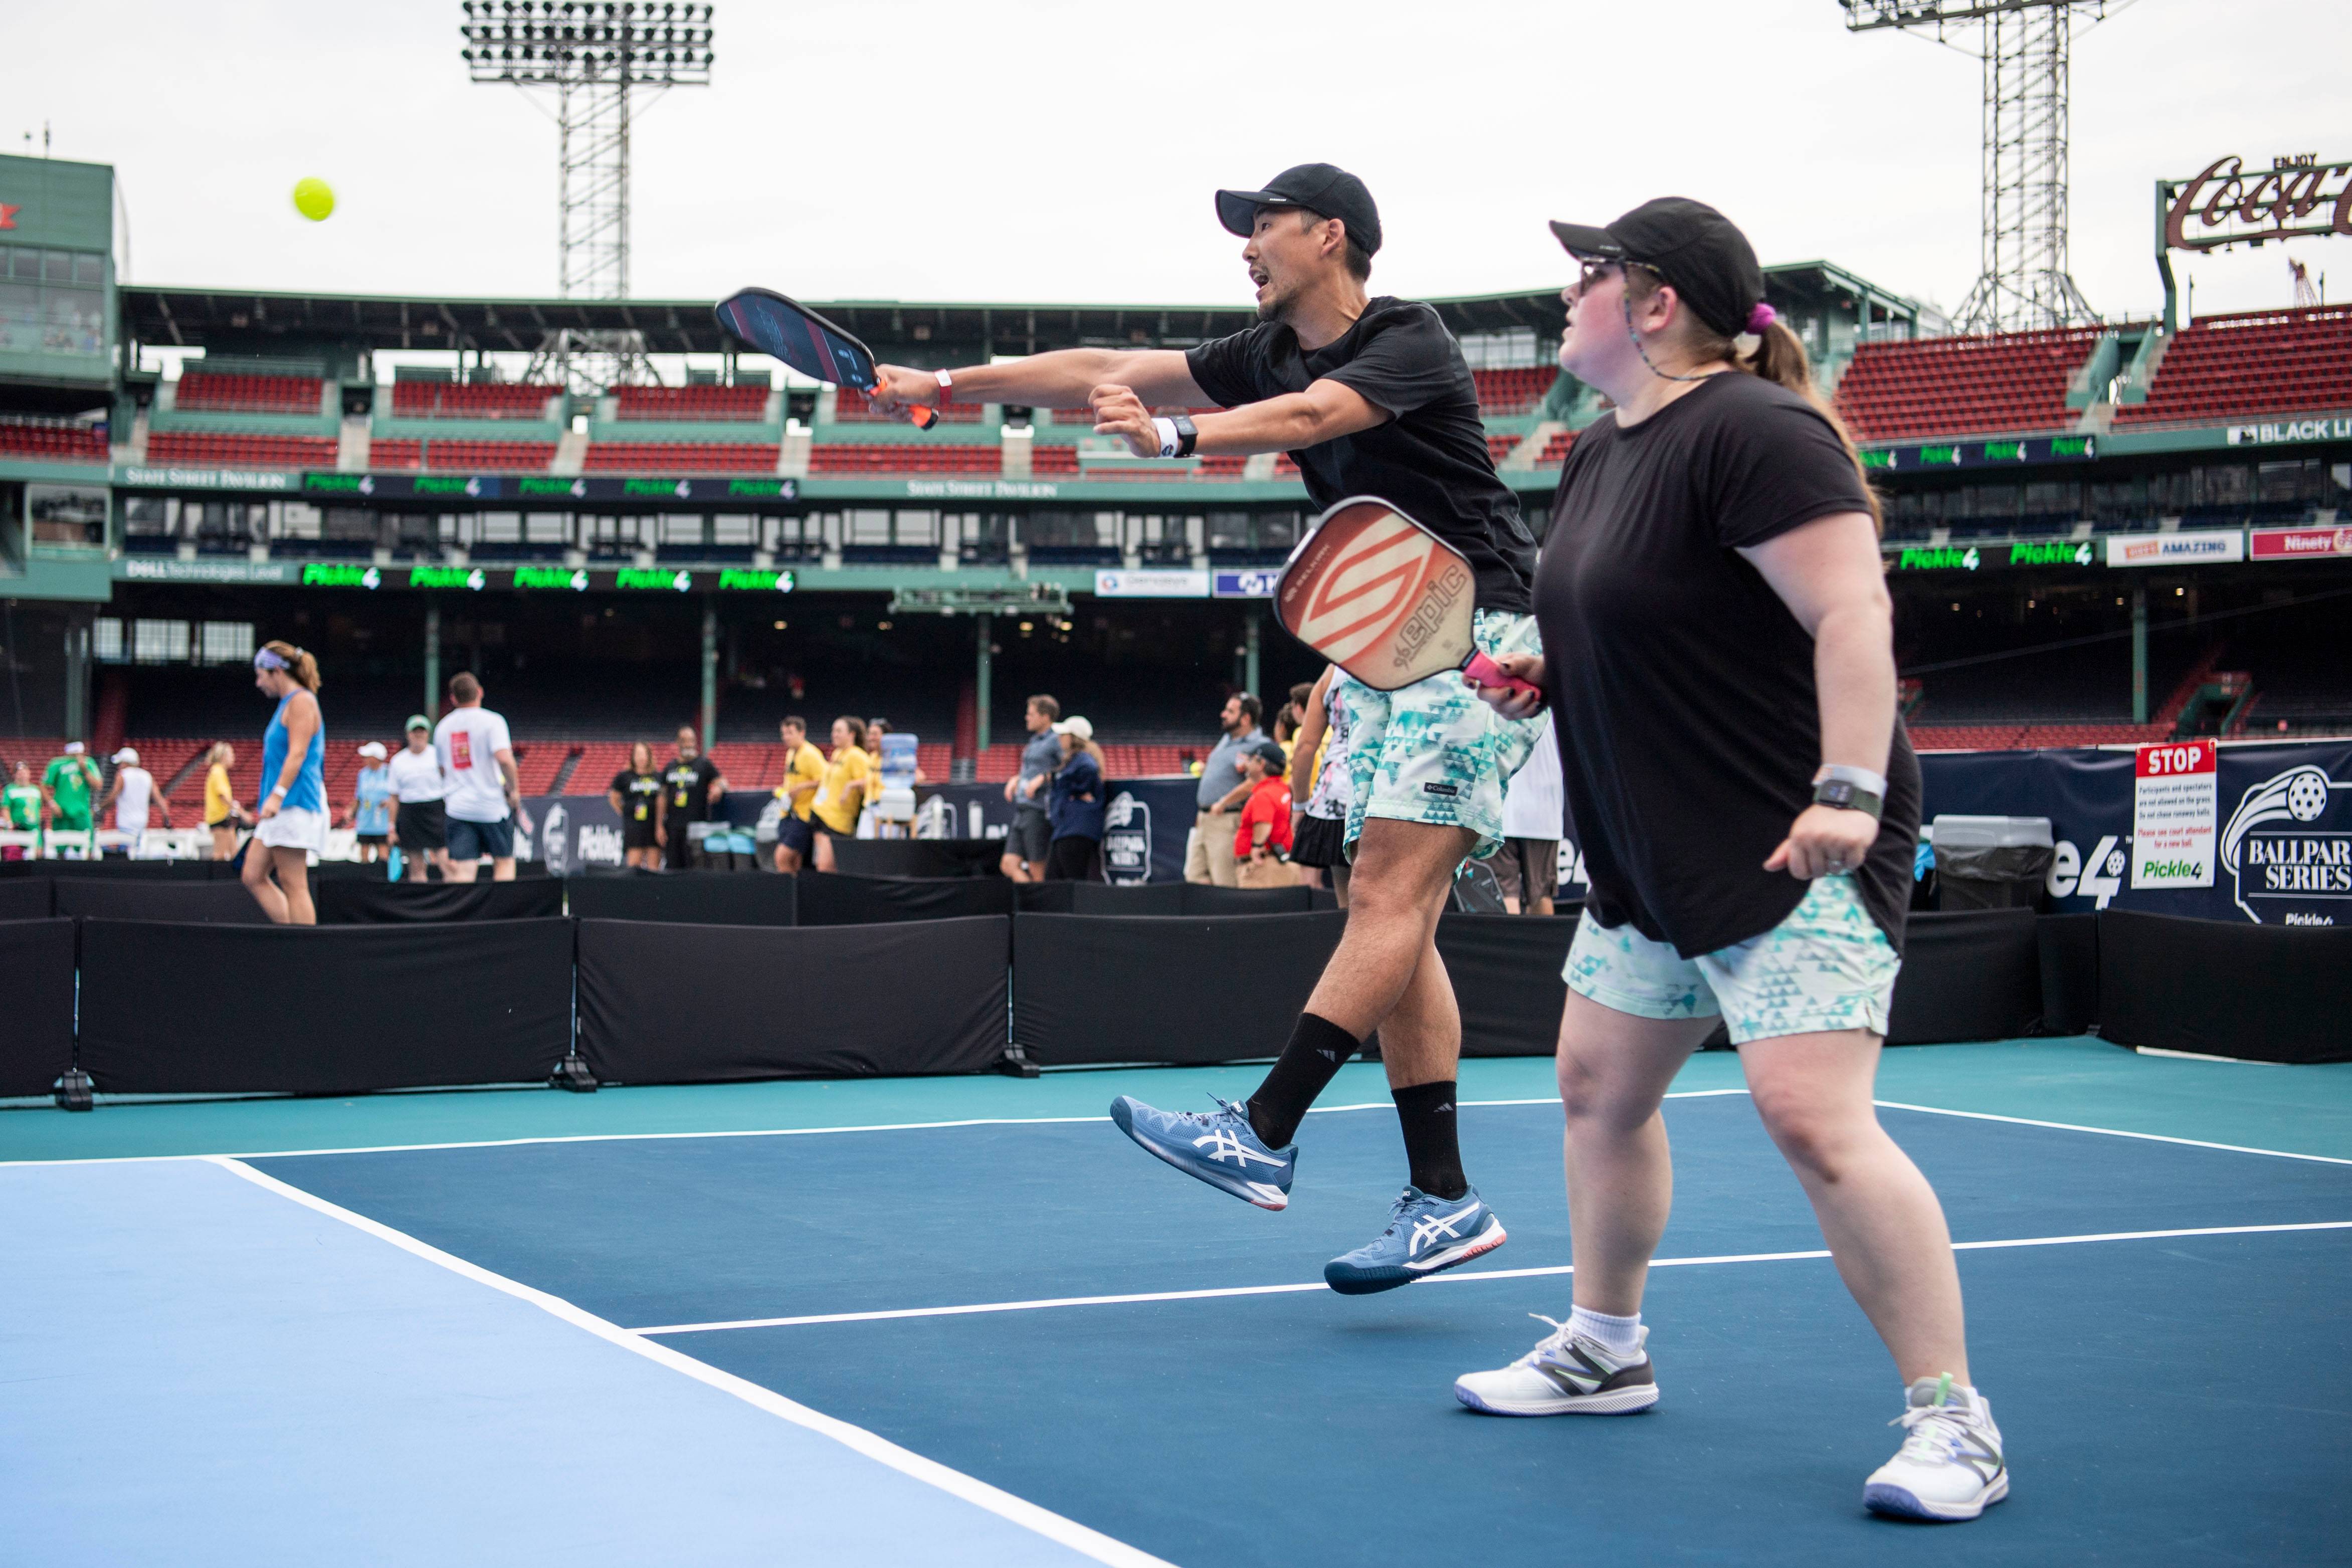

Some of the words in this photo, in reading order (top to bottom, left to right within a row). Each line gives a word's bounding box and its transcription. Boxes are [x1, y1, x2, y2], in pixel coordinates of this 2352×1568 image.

[2273, 153, 2317, 168] ENJOY
[2260, 420, 2328, 443] BLACK
[2009, 540, 2093, 566] Pickle4
[2162, 540, 2226, 554] AMAZING
[2284, 535, 2331, 551] Ninety
[1900, 545, 1980, 571] Pickle4
[1399, 564, 1468, 649] epic
[2148, 746, 2202, 774] STOP
[2139, 785, 2170, 795] Participants
[2172, 783, 2181, 792] and
[2183, 782, 2212, 792] spectators
[2158, 796, 2177, 806] allowed
[2139, 811, 2145, 819] Do
[2173, 810, 2195, 819] runaway
[2138, 827, 2155, 837] Please
[2158, 828, 2167, 836] see
[2169, 826, 2183, 836] court
[2185, 825, 2212, 835] attendant
[2249, 839, 2352, 865] BALLPAR
[2142, 858, 2203, 881] Pickle4
[2265, 864, 2352, 891] SERIES
